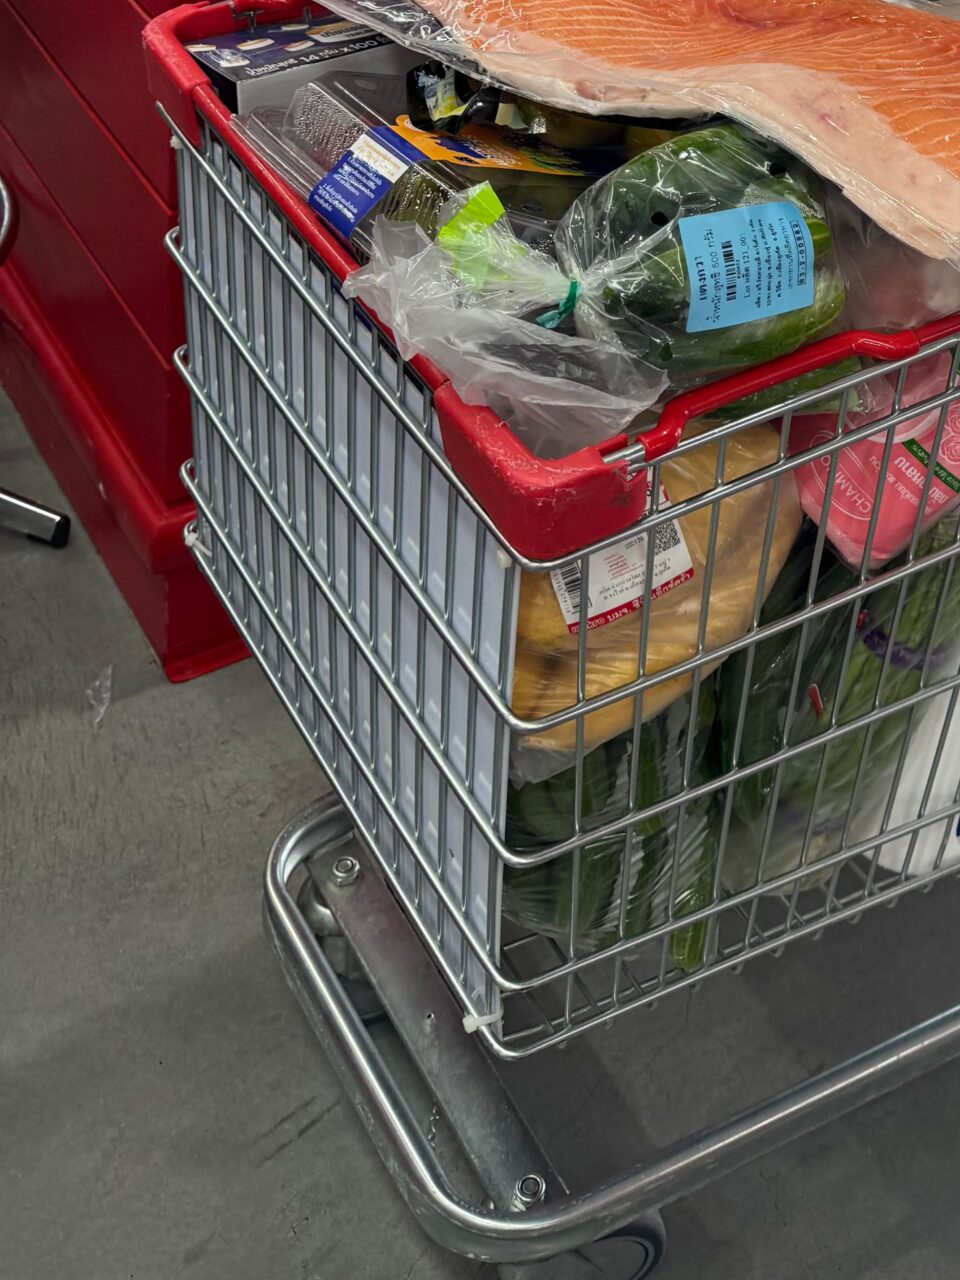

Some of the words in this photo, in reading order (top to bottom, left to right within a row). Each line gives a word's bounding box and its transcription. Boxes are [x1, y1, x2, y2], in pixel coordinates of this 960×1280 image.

[299, 54, 320, 63] 14
[350, 39, 378, 50] 100
[710, 251, 719, 269] 500
[694, 245, 708, 301] แตงกวา
